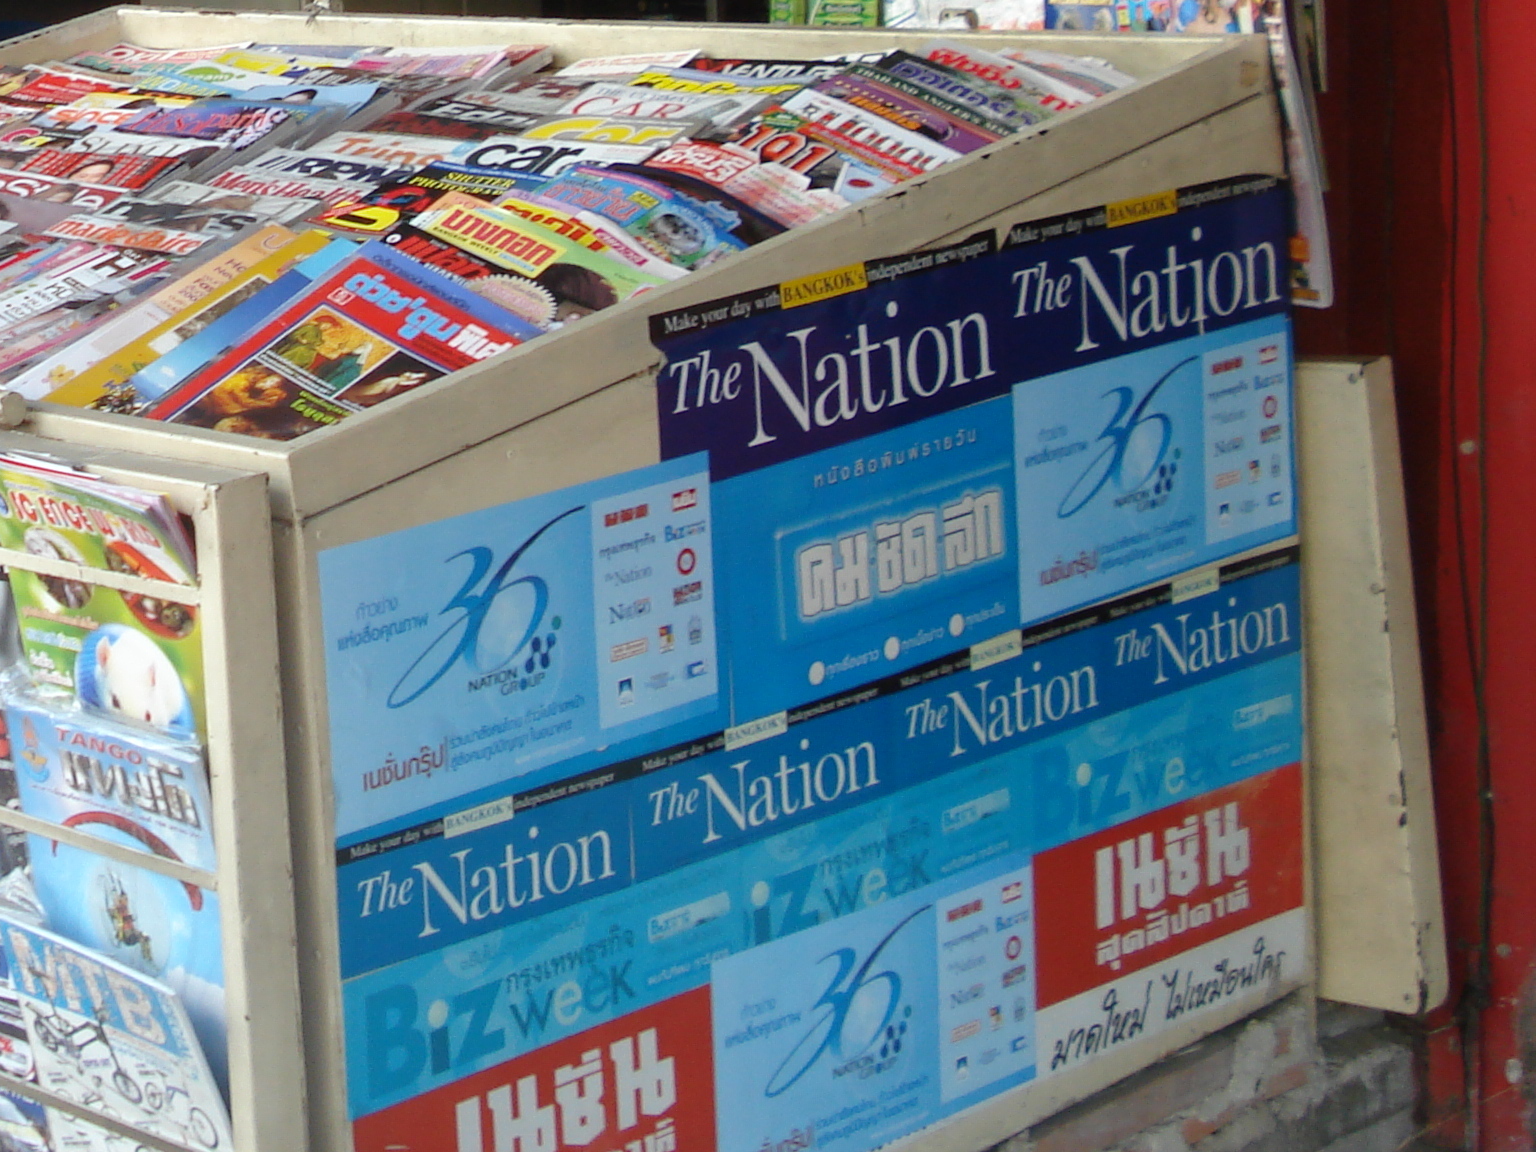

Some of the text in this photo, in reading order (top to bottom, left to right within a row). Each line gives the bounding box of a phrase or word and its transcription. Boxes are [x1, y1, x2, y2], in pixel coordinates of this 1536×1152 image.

[736, 120, 837, 175] 101
[440, 206, 557, 268] บางกอก
[664, 312, 700, 335] Make
[700, 303, 730, 330] your
[730, 298, 753, 319] day
[782, 268, 866, 304] BANGKOK's
[866, 250, 934, 282] independent
[934, 236, 990, 267] newspaper
[1012, 226, 1284, 355] The Nation
[670, 299, 997, 448] The Nation
[1057, 354, 1201, 520] 36
[386, 503, 587, 709] 36
[1115, 628, 1153, 668] The
[1150, 596, 1291, 686] Nation
[467, 668, 519, 693] NATION
[500, 672, 547, 698] GROUP
[905, 697, 948, 741] The
[946, 660, 1099, 757] Nation
[56, 726, 143, 766] TANGO
[362, 744, 446, 793] เนชั่นกรุ๊ป
[649, 738, 881, 845] The Nation
[357, 865, 413, 919] The
[411, 824, 616, 939] Nation
[1095, 801, 1252, 932] เนชั่น
[763, 903, 936, 1100] 36
